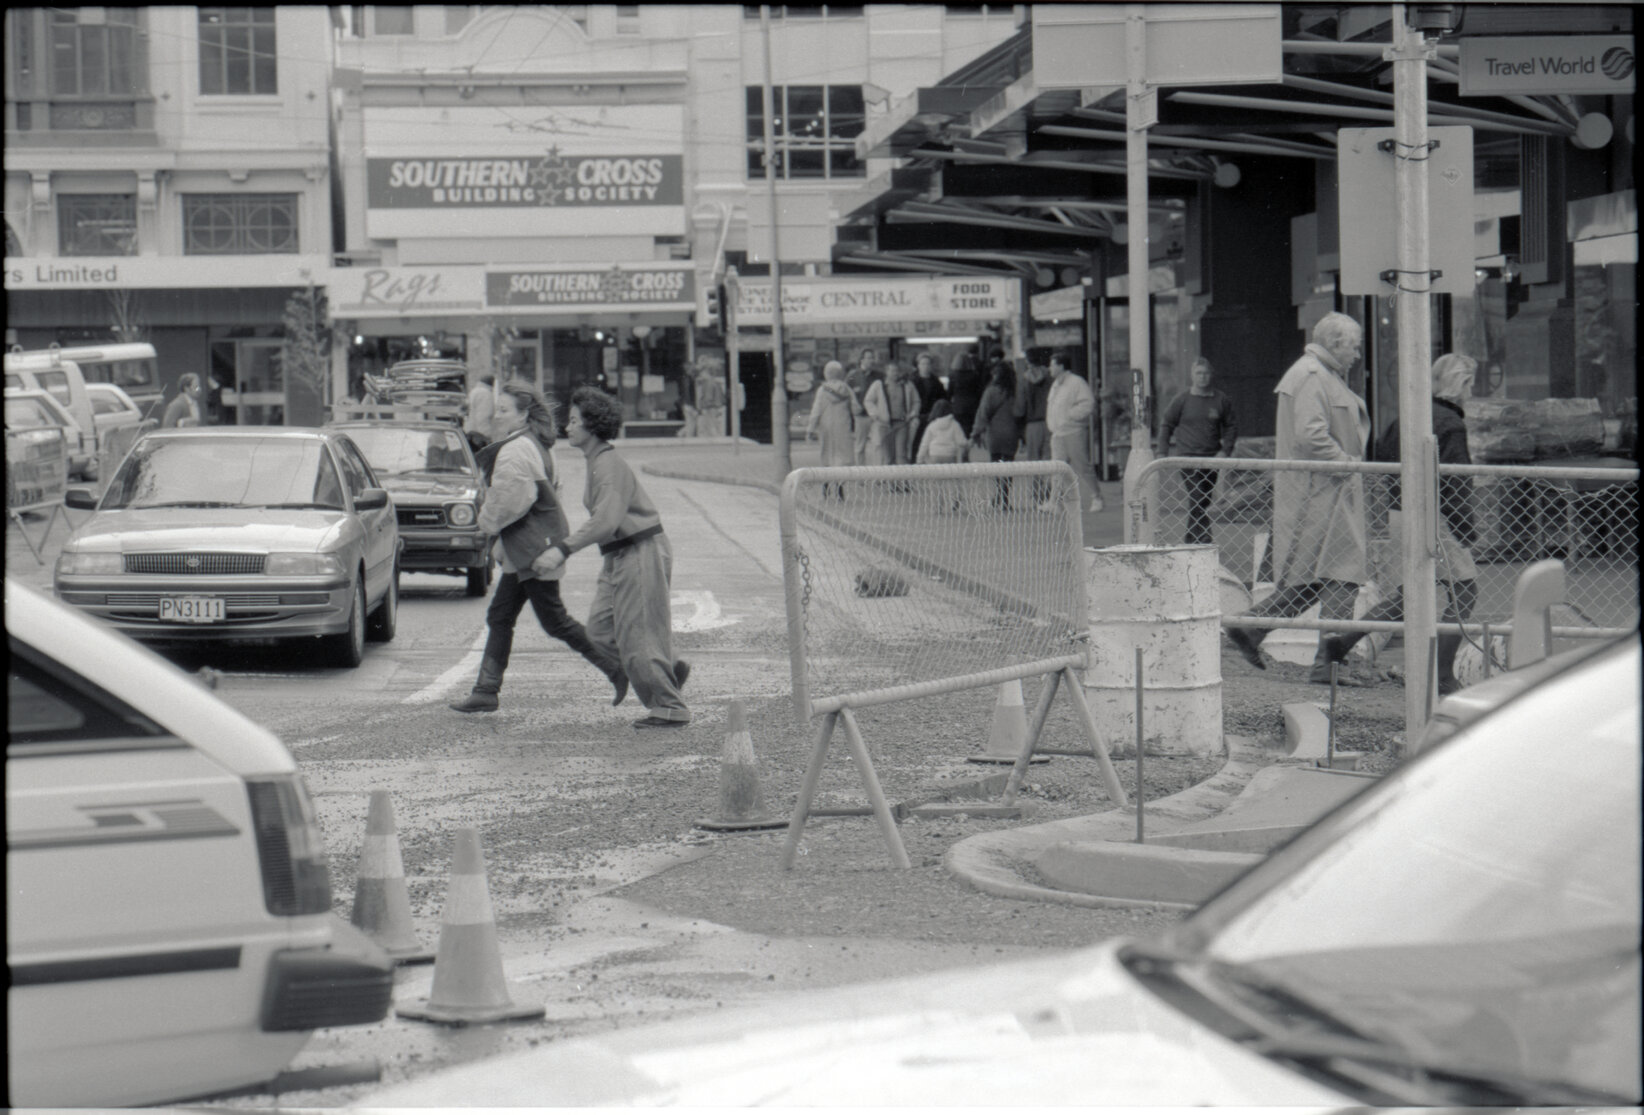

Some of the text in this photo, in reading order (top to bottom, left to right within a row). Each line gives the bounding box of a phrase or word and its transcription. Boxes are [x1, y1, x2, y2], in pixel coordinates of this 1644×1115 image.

[1485, 56, 1595, 76] Travel World
[389, 158, 663, 188] SOUTHERN CROSS
[433, 185, 658, 203] BUILDING SOCIETY
[36, 264, 118, 282] Limited
[510, 272, 685, 292] SOUTHERN CROSS
[361, 269, 442, 313] Rags
[538, 290, 679, 302] BUILDING SOCIETY
[953, 283, 991, 294] FOOD
[820, 290, 911, 308] CENTRAL
[951, 297, 996, 309] STORE
[162, 600, 221, 617] PN3111
